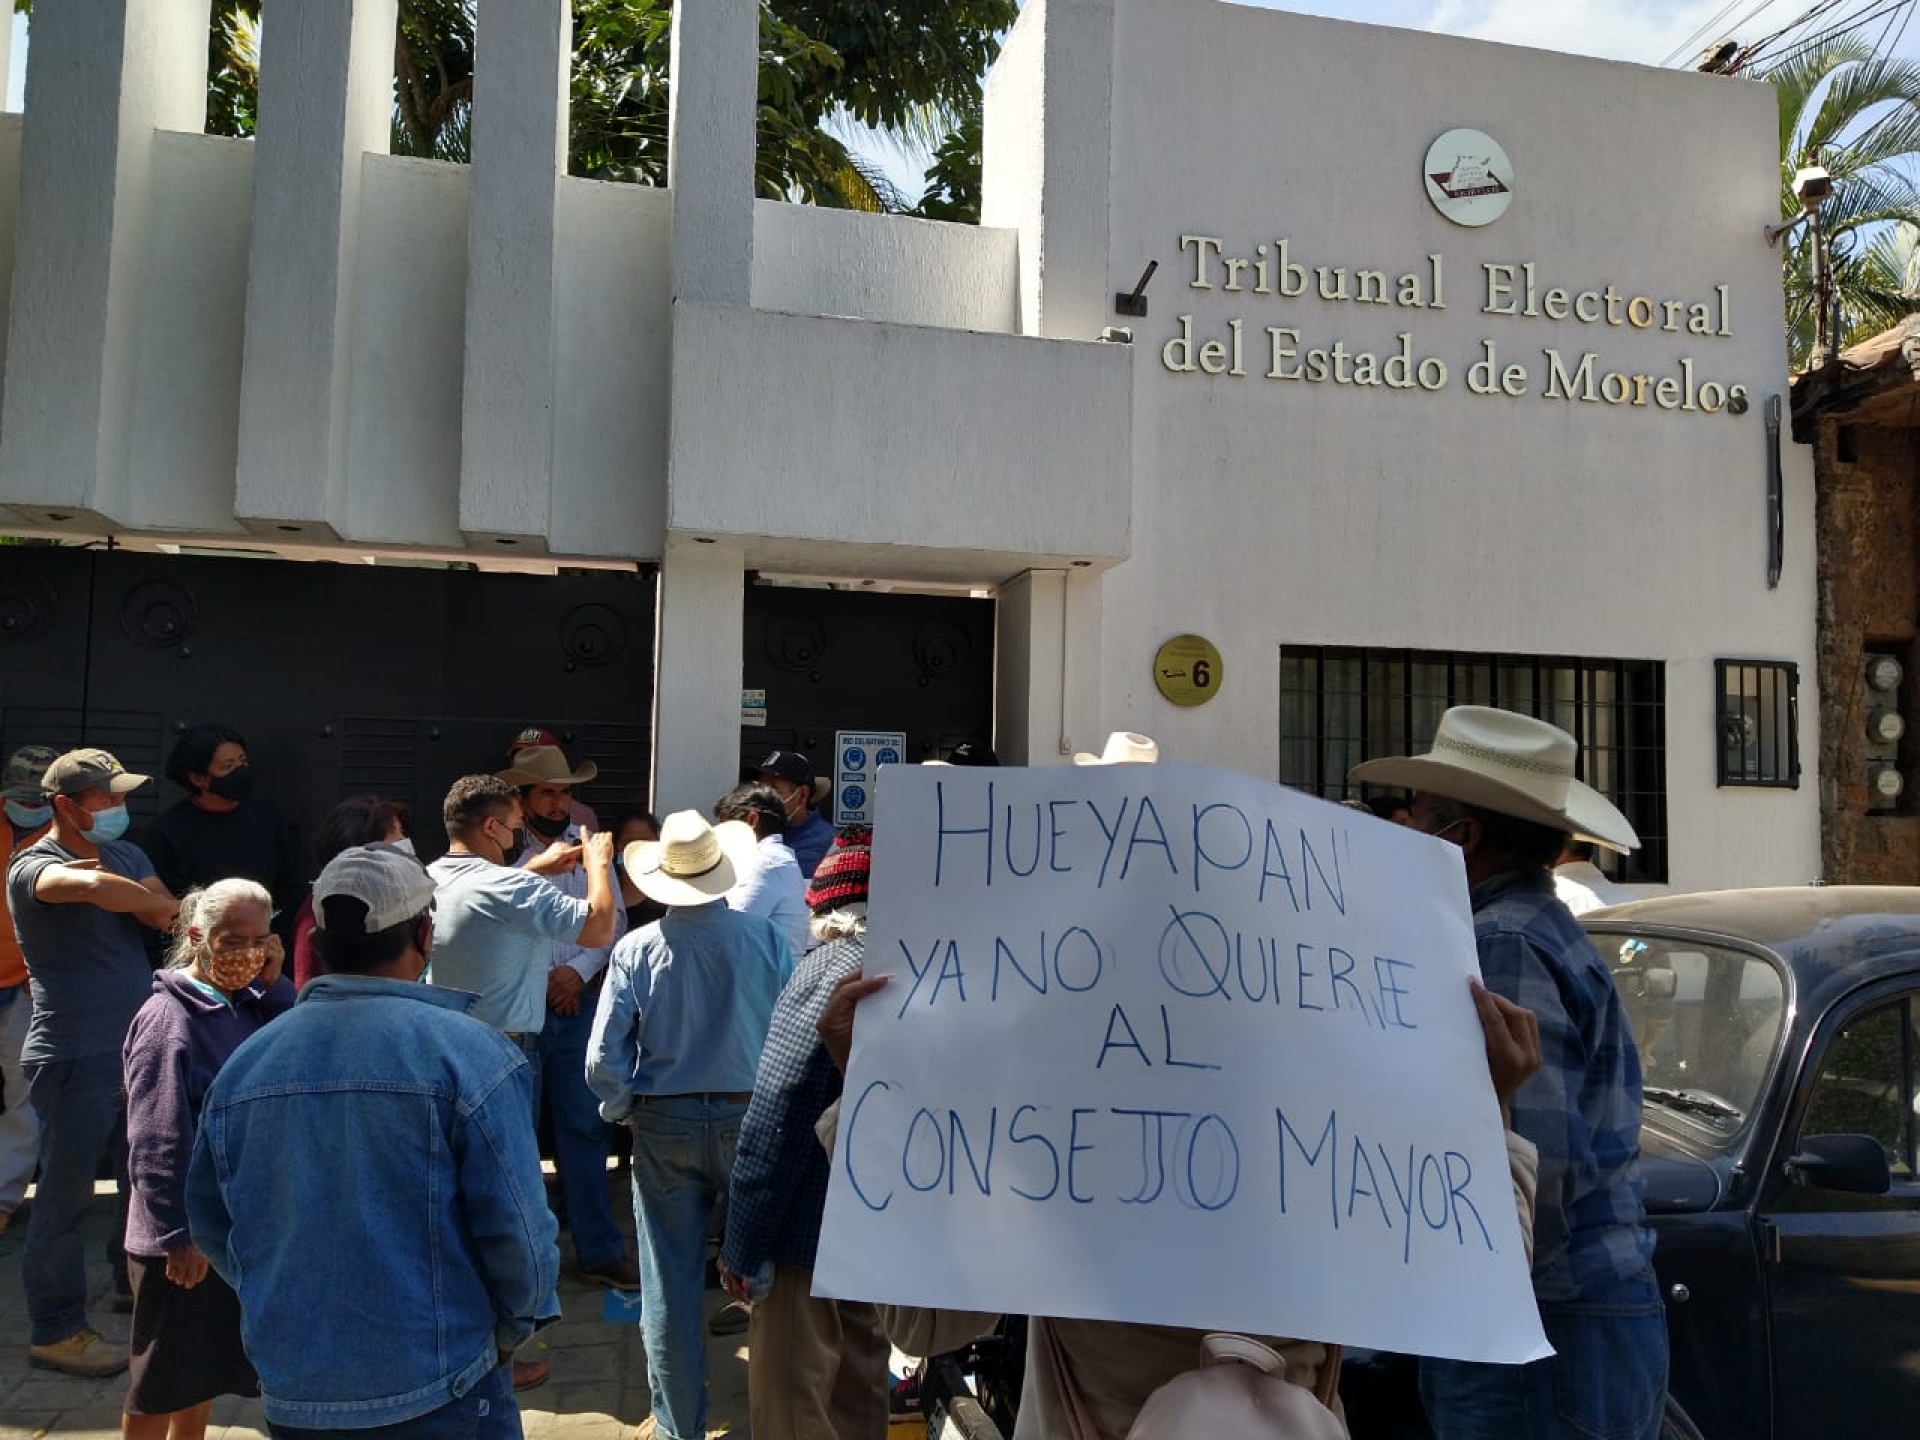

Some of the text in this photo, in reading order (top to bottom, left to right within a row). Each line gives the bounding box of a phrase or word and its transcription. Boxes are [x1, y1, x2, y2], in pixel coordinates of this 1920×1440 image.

[1180, 234, 1733, 336] Tribunal Electoral
[1161, 315, 1749, 415] del Estado de Morelos
[1193, 659, 1210, 688] 6
[935, 781, 1348, 915] HUEYAPAN
[1158, 904, 1419, 1031] QUIERE
[1097, 1004, 1222, 1070] AL
[845, 1080, 1496, 1263] CONSEJO MAYOR
